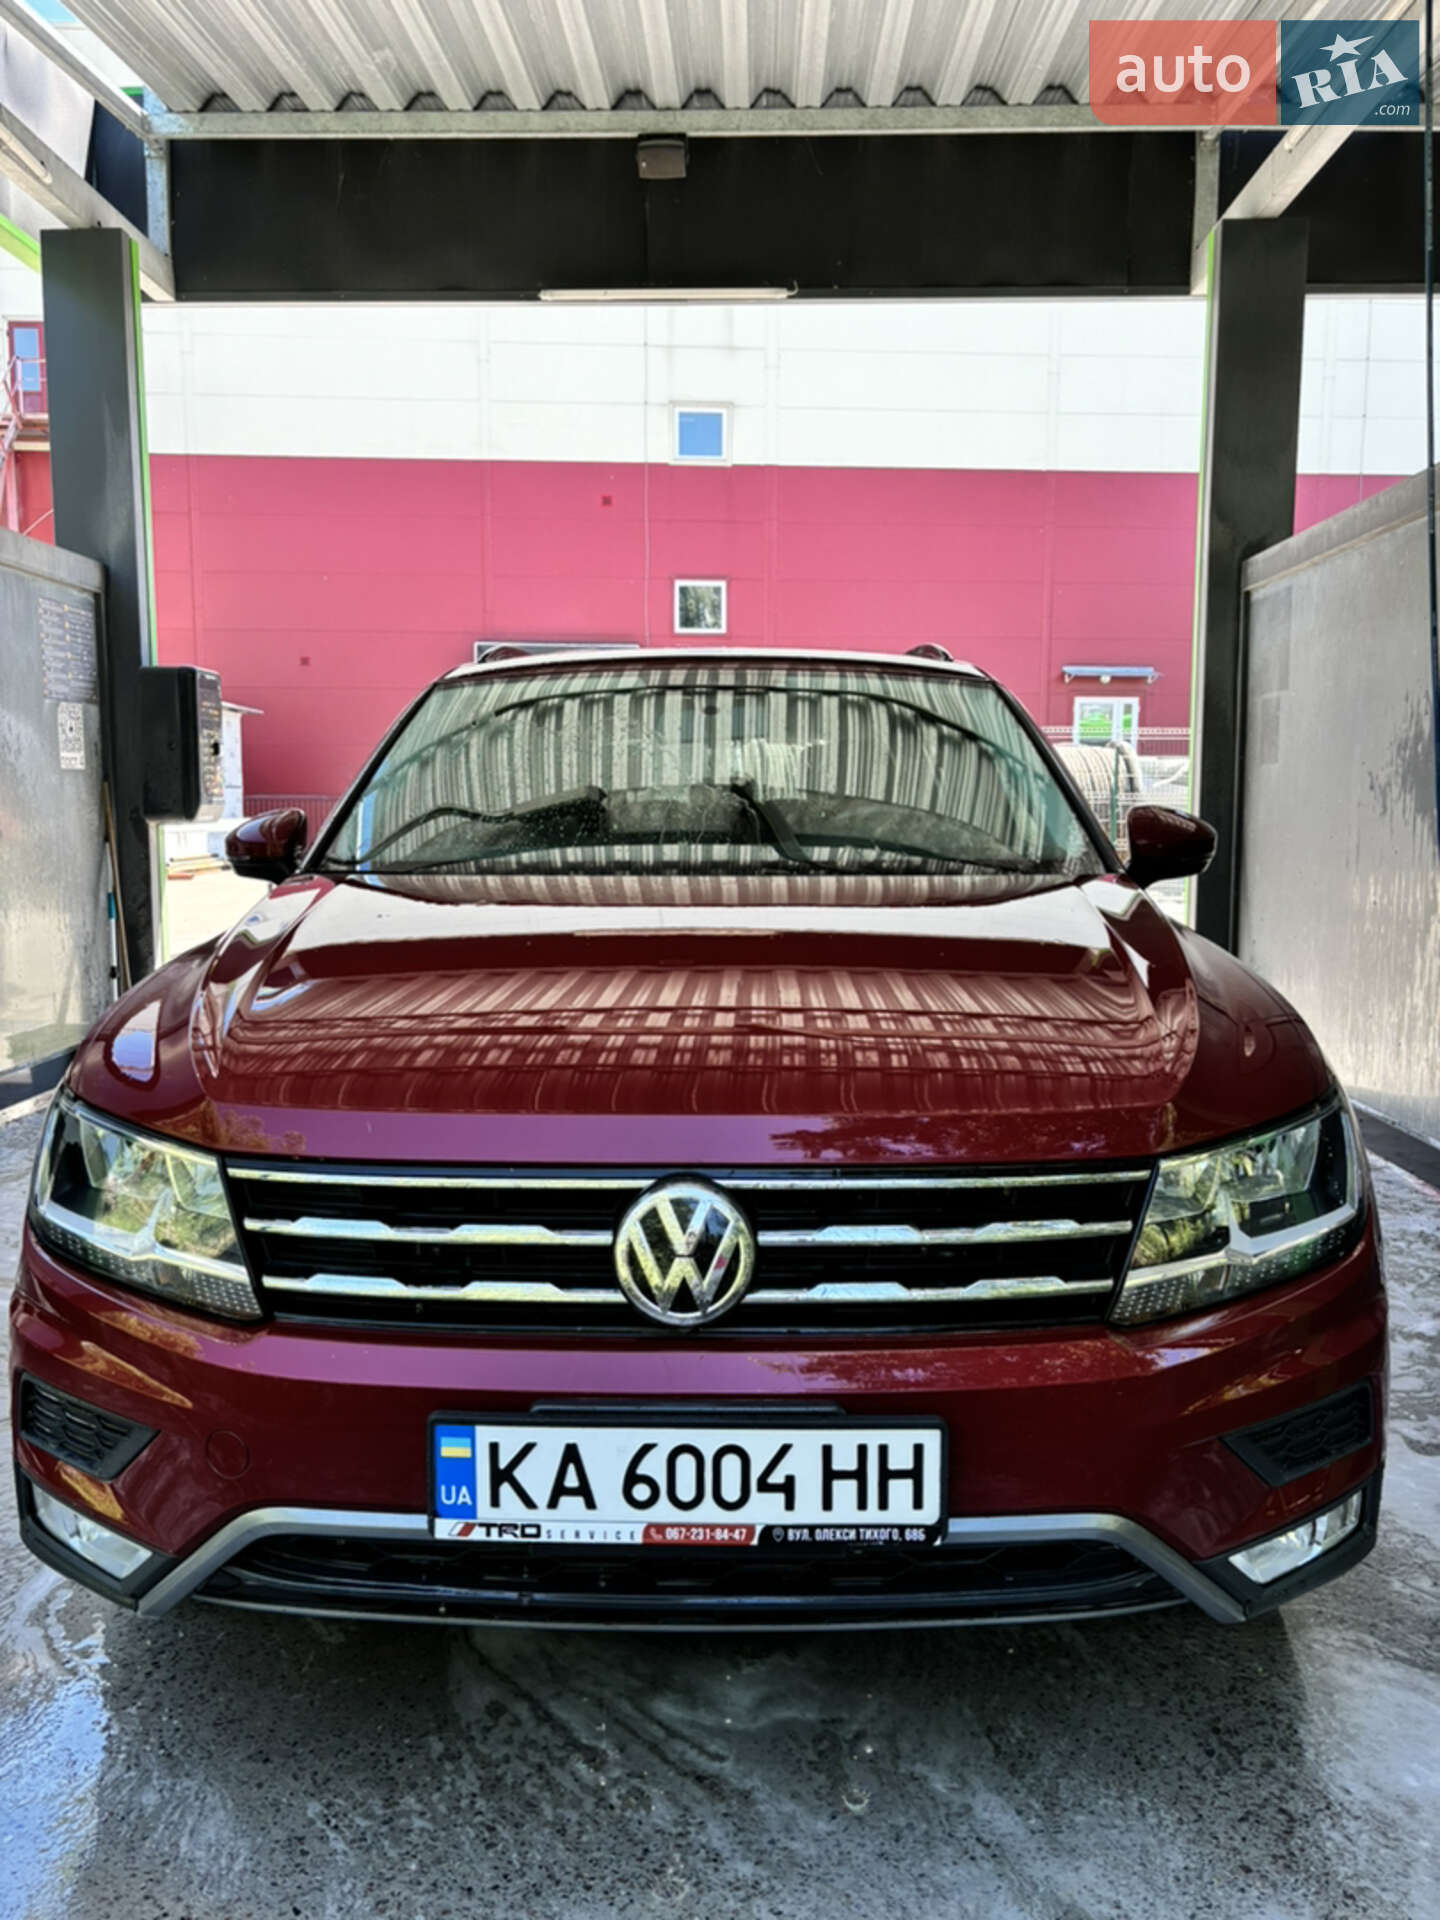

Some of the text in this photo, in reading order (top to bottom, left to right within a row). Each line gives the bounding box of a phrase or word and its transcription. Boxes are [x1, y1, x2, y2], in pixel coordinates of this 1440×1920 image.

[488, 1441, 925, 1512] KA 6004 HH
[440, 1485, 473, 1506] UA
[545, 1529, 636, 1542] SERVICE
[814, 1527, 857, 1541] ОЛЕКСИ
